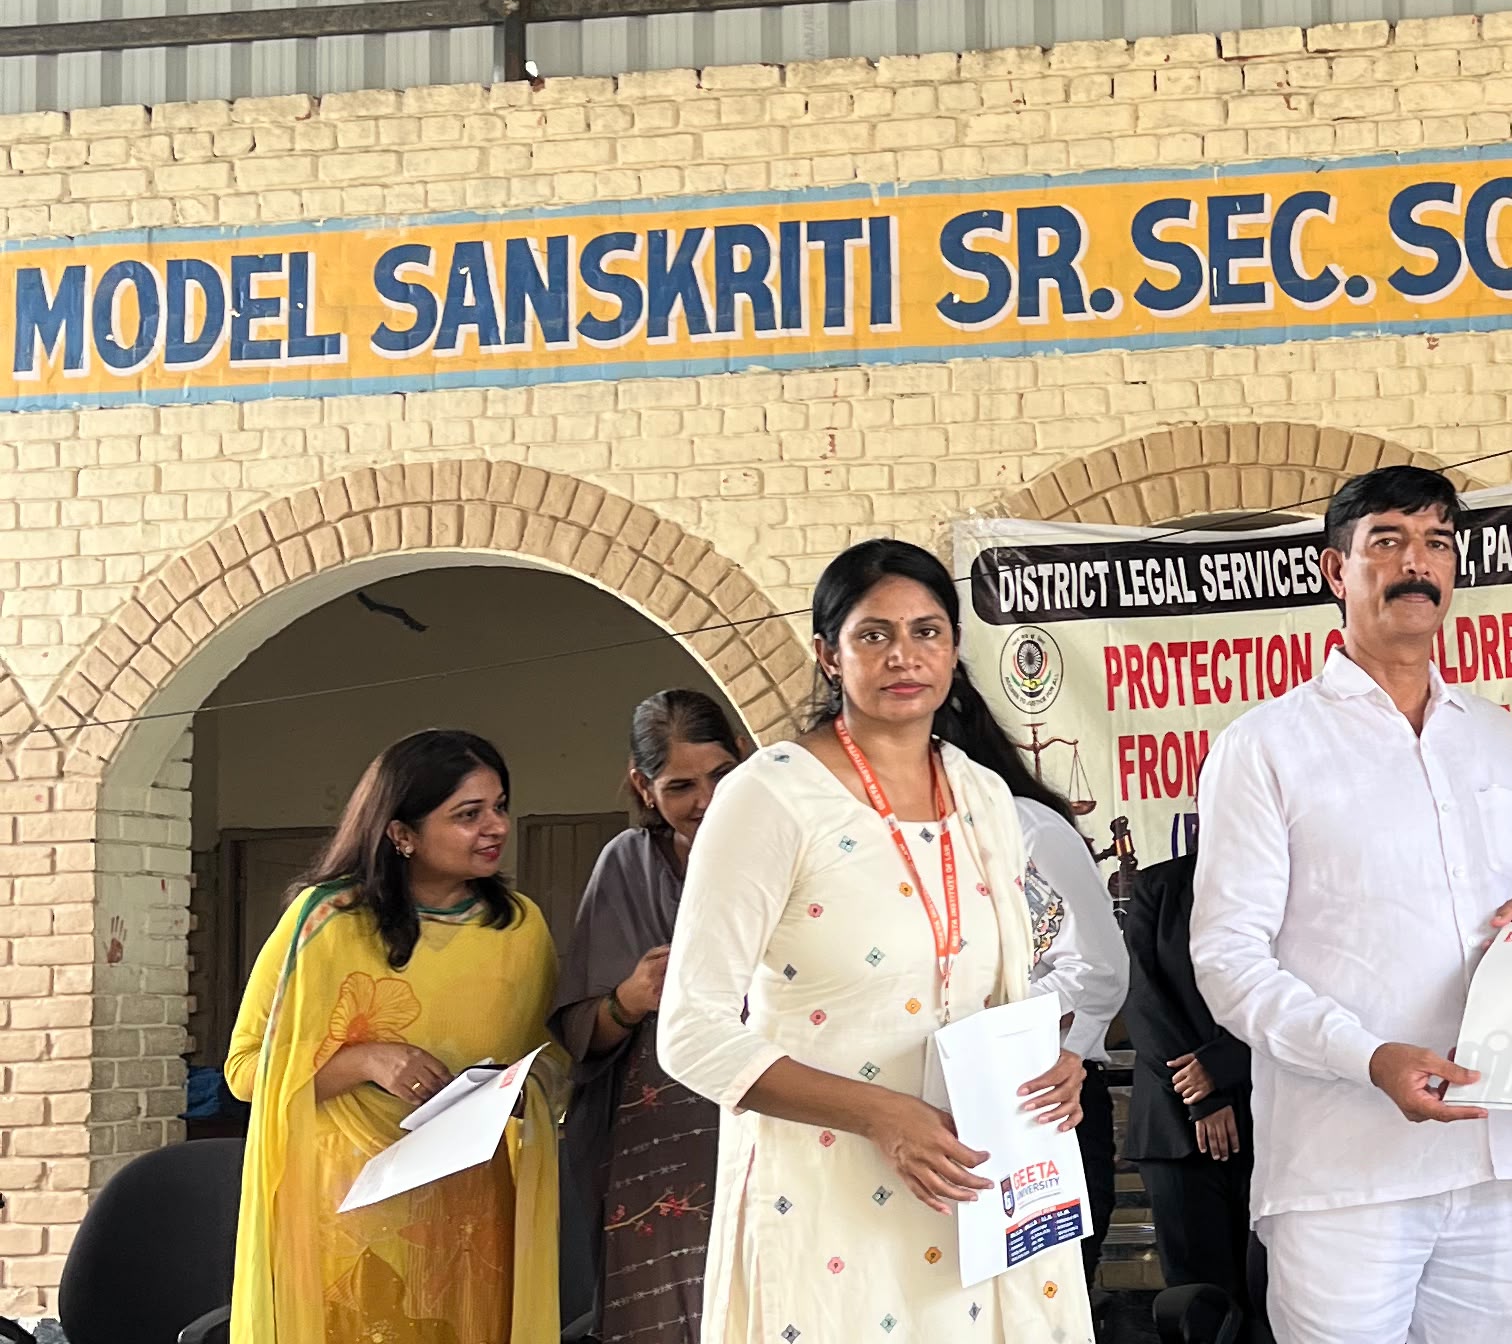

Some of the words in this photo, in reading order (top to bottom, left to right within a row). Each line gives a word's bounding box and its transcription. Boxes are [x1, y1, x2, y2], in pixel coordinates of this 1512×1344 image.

[13, 251, 344, 376] MODEL
[371, 216, 893, 355] SANSKRITI
[998, 560, 1111, 613] DISTRICT
[1116, 557, 1198, 607] LEGAL
[1200, 545, 1323, 602] SERVICES
[1104, 632, 1313, 711] PROTECTION
[1118, 730, 1209, 801] FROM
[1013, 1159, 1060, 1190] GEETA
